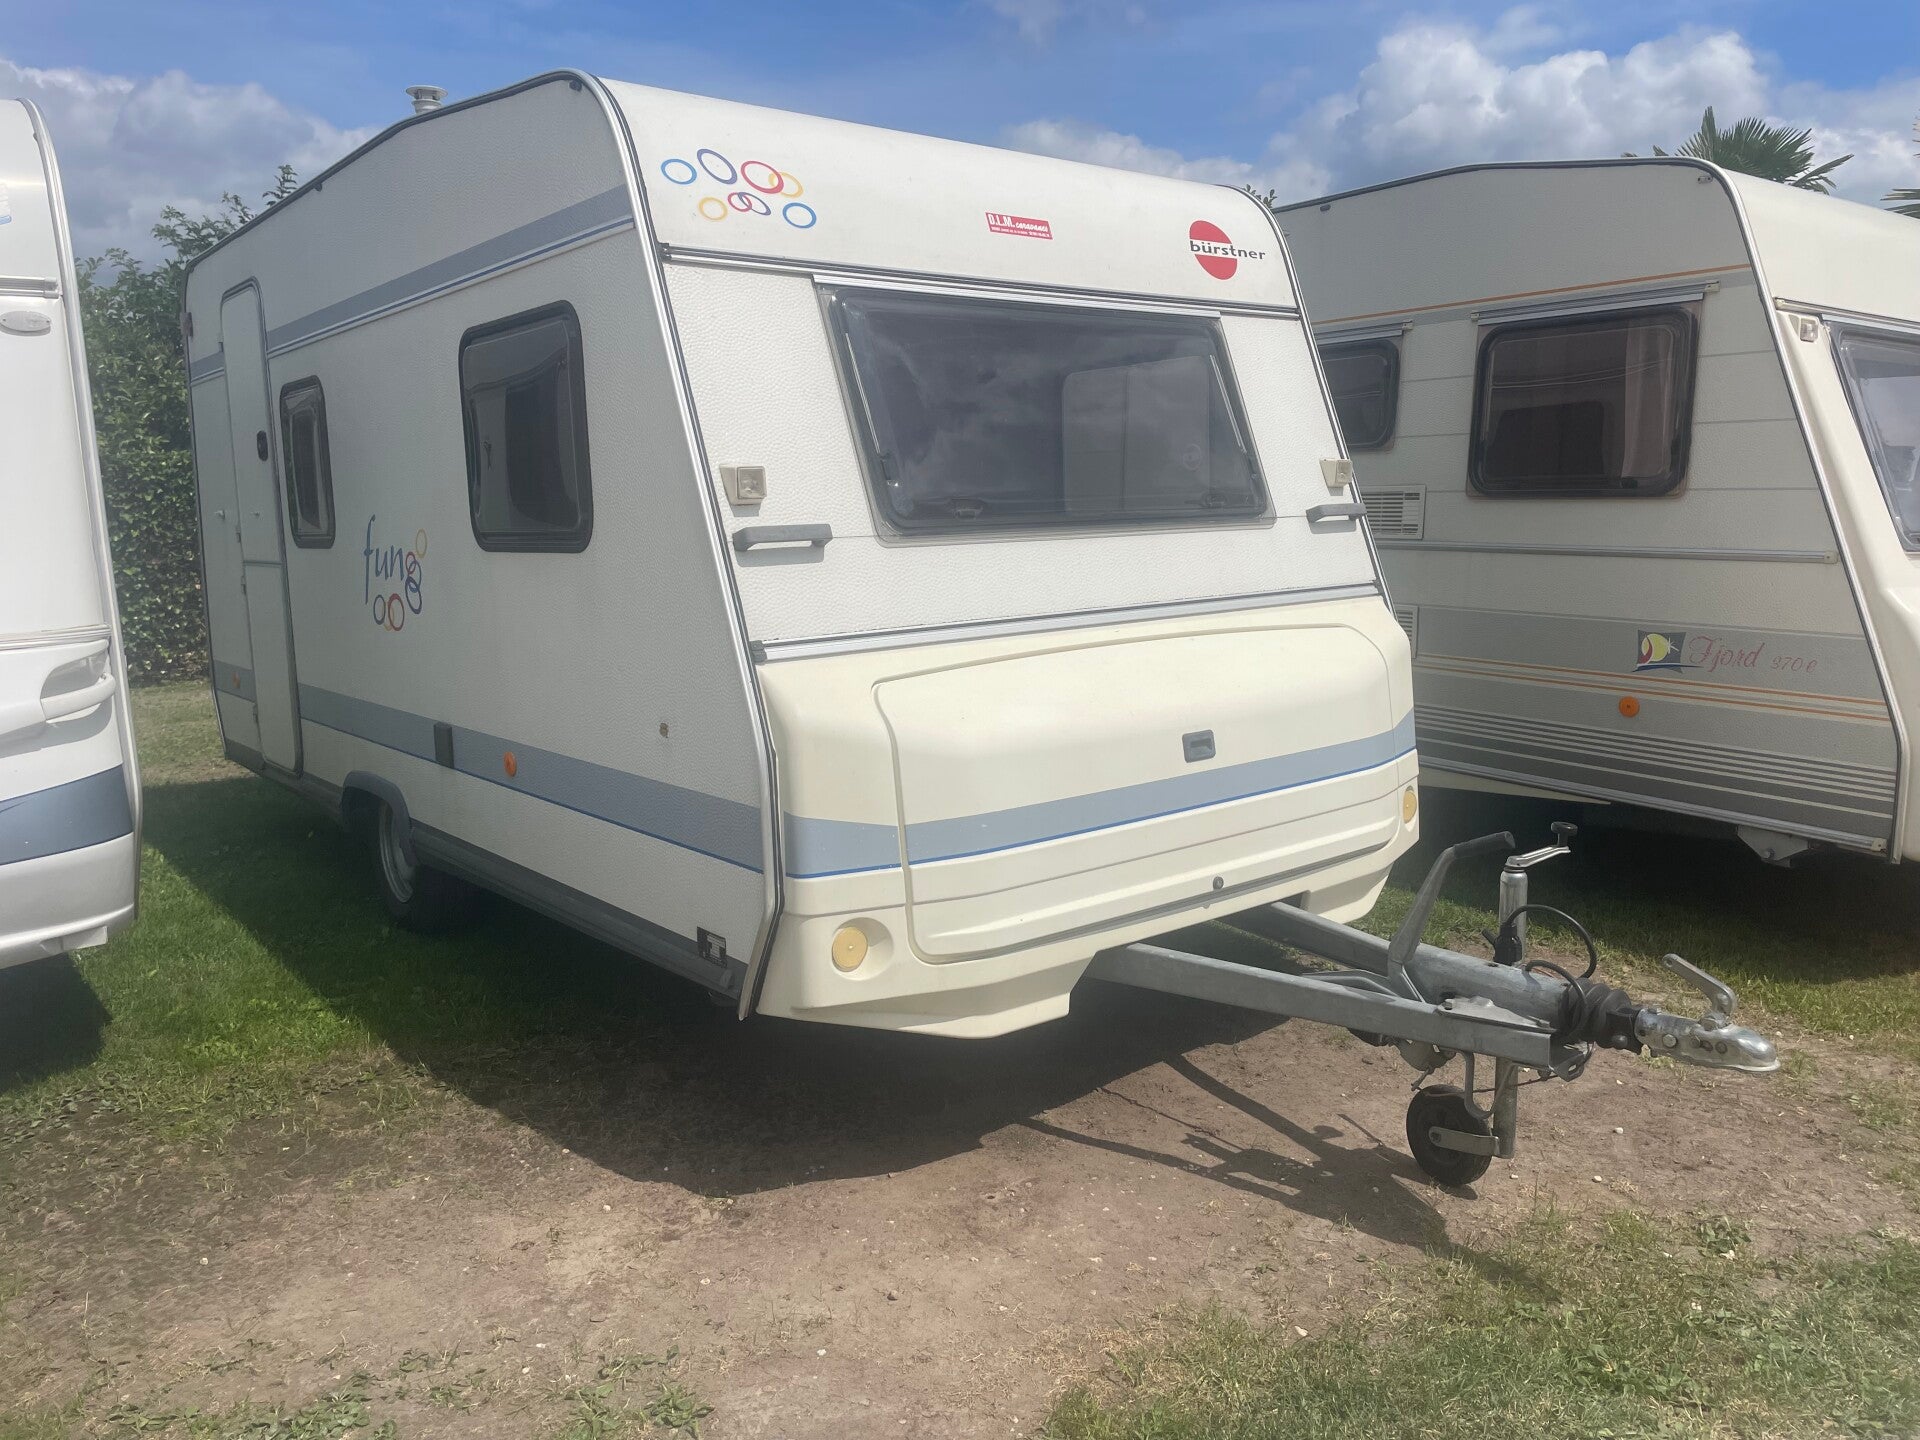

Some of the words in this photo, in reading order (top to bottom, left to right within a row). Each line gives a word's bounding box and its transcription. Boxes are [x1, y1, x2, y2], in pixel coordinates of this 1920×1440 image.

[1190, 240, 1266, 260] bürstner
[364, 514, 404, 605] fun
[1689, 635, 1765, 672] Fjord
